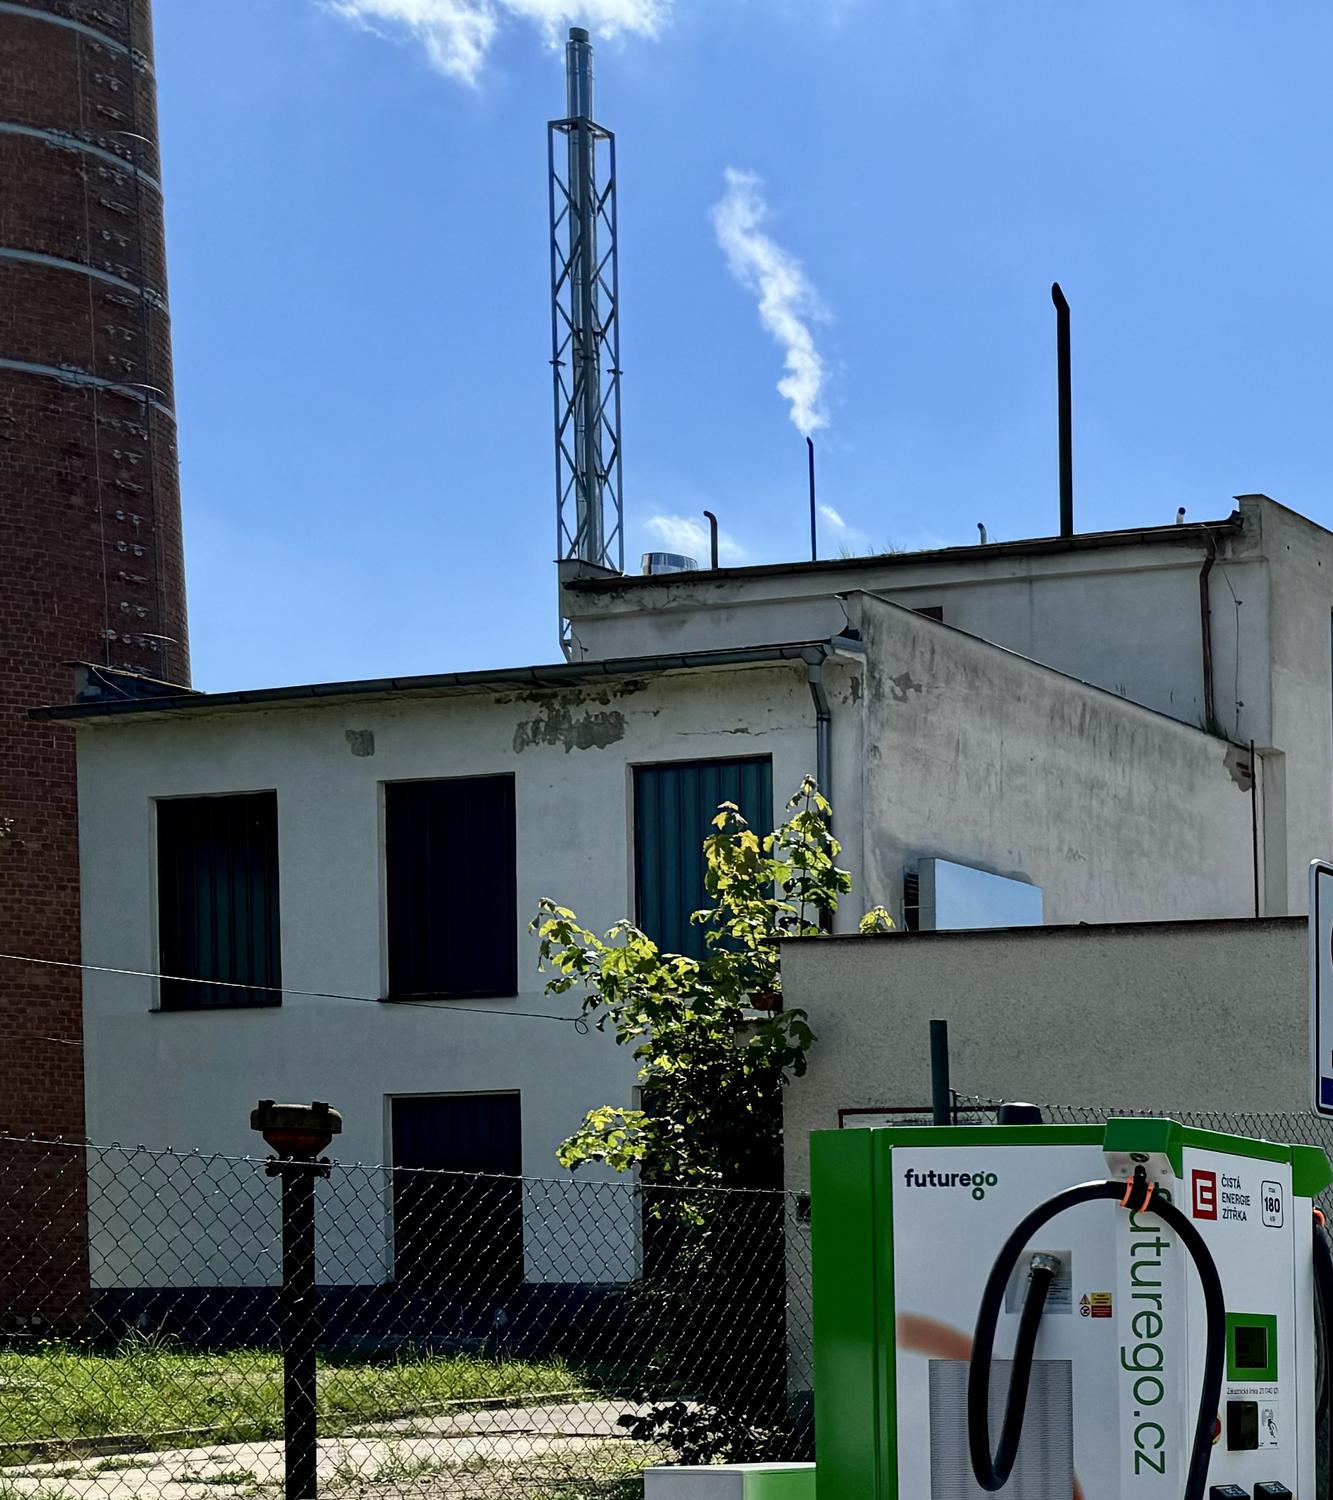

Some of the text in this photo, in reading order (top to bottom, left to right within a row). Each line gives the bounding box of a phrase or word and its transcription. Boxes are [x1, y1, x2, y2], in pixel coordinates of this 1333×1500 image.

[904, 1168, 998, 1201] futurego
[1221, 1174, 1241, 1190] ČISTÁ
[1221, 1192, 1251, 1207] ENERGIE
[1264, 1196, 1280, 1213] 180
[1222, 1207, 1248, 1222] ZÍTŘKA
